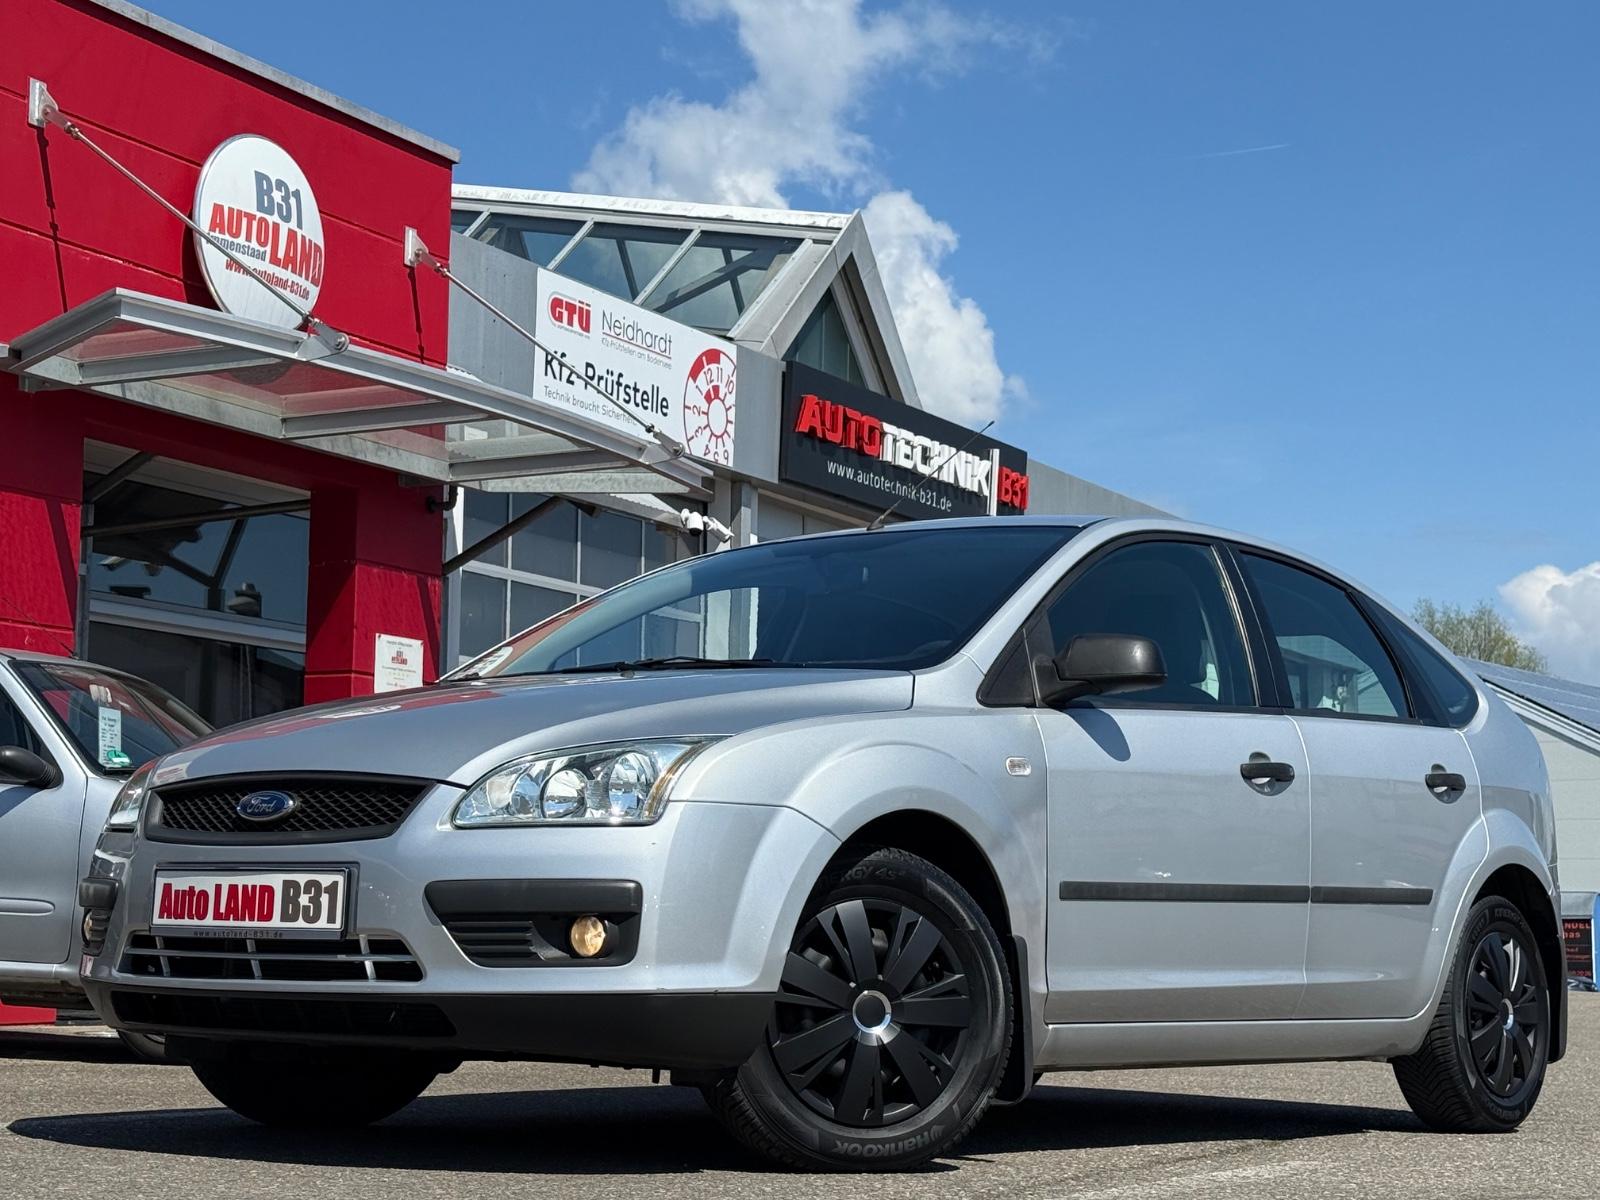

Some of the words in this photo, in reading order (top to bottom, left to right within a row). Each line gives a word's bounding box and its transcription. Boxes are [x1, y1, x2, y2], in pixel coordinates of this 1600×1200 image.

[254, 170, 303, 231] B31
[208, 202, 323, 288] AUTOLAND
[549, 296, 592, 334] GTÜ
[602, 309, 673, 357] Neidhardt
[544, 349, 670, 418] Kfz-Prüfstelle
[703, 367, 714, 386] 12
[716, 366, 725, 383] 11
[726, 375, 735, 395] 10
[544, 385, 572, 403] Technik
[572, 393, 600, 414] braucht
[601, 404, 638, 426] Sicherhe
[692, 404, 702, 417] 2
[694, 426, 704, 438] 3
[703, 444, 711, 457] 4
[826, 459, 953, 513] www.autotechnik-b31.de
[1000, 465, 1030, 512] B31
[246, 796, 278, 813] Ford
[157, 882, 210, 921] Auto
[212, 883, 275, 922] LAND
[279, 879, 340, 924] B31
